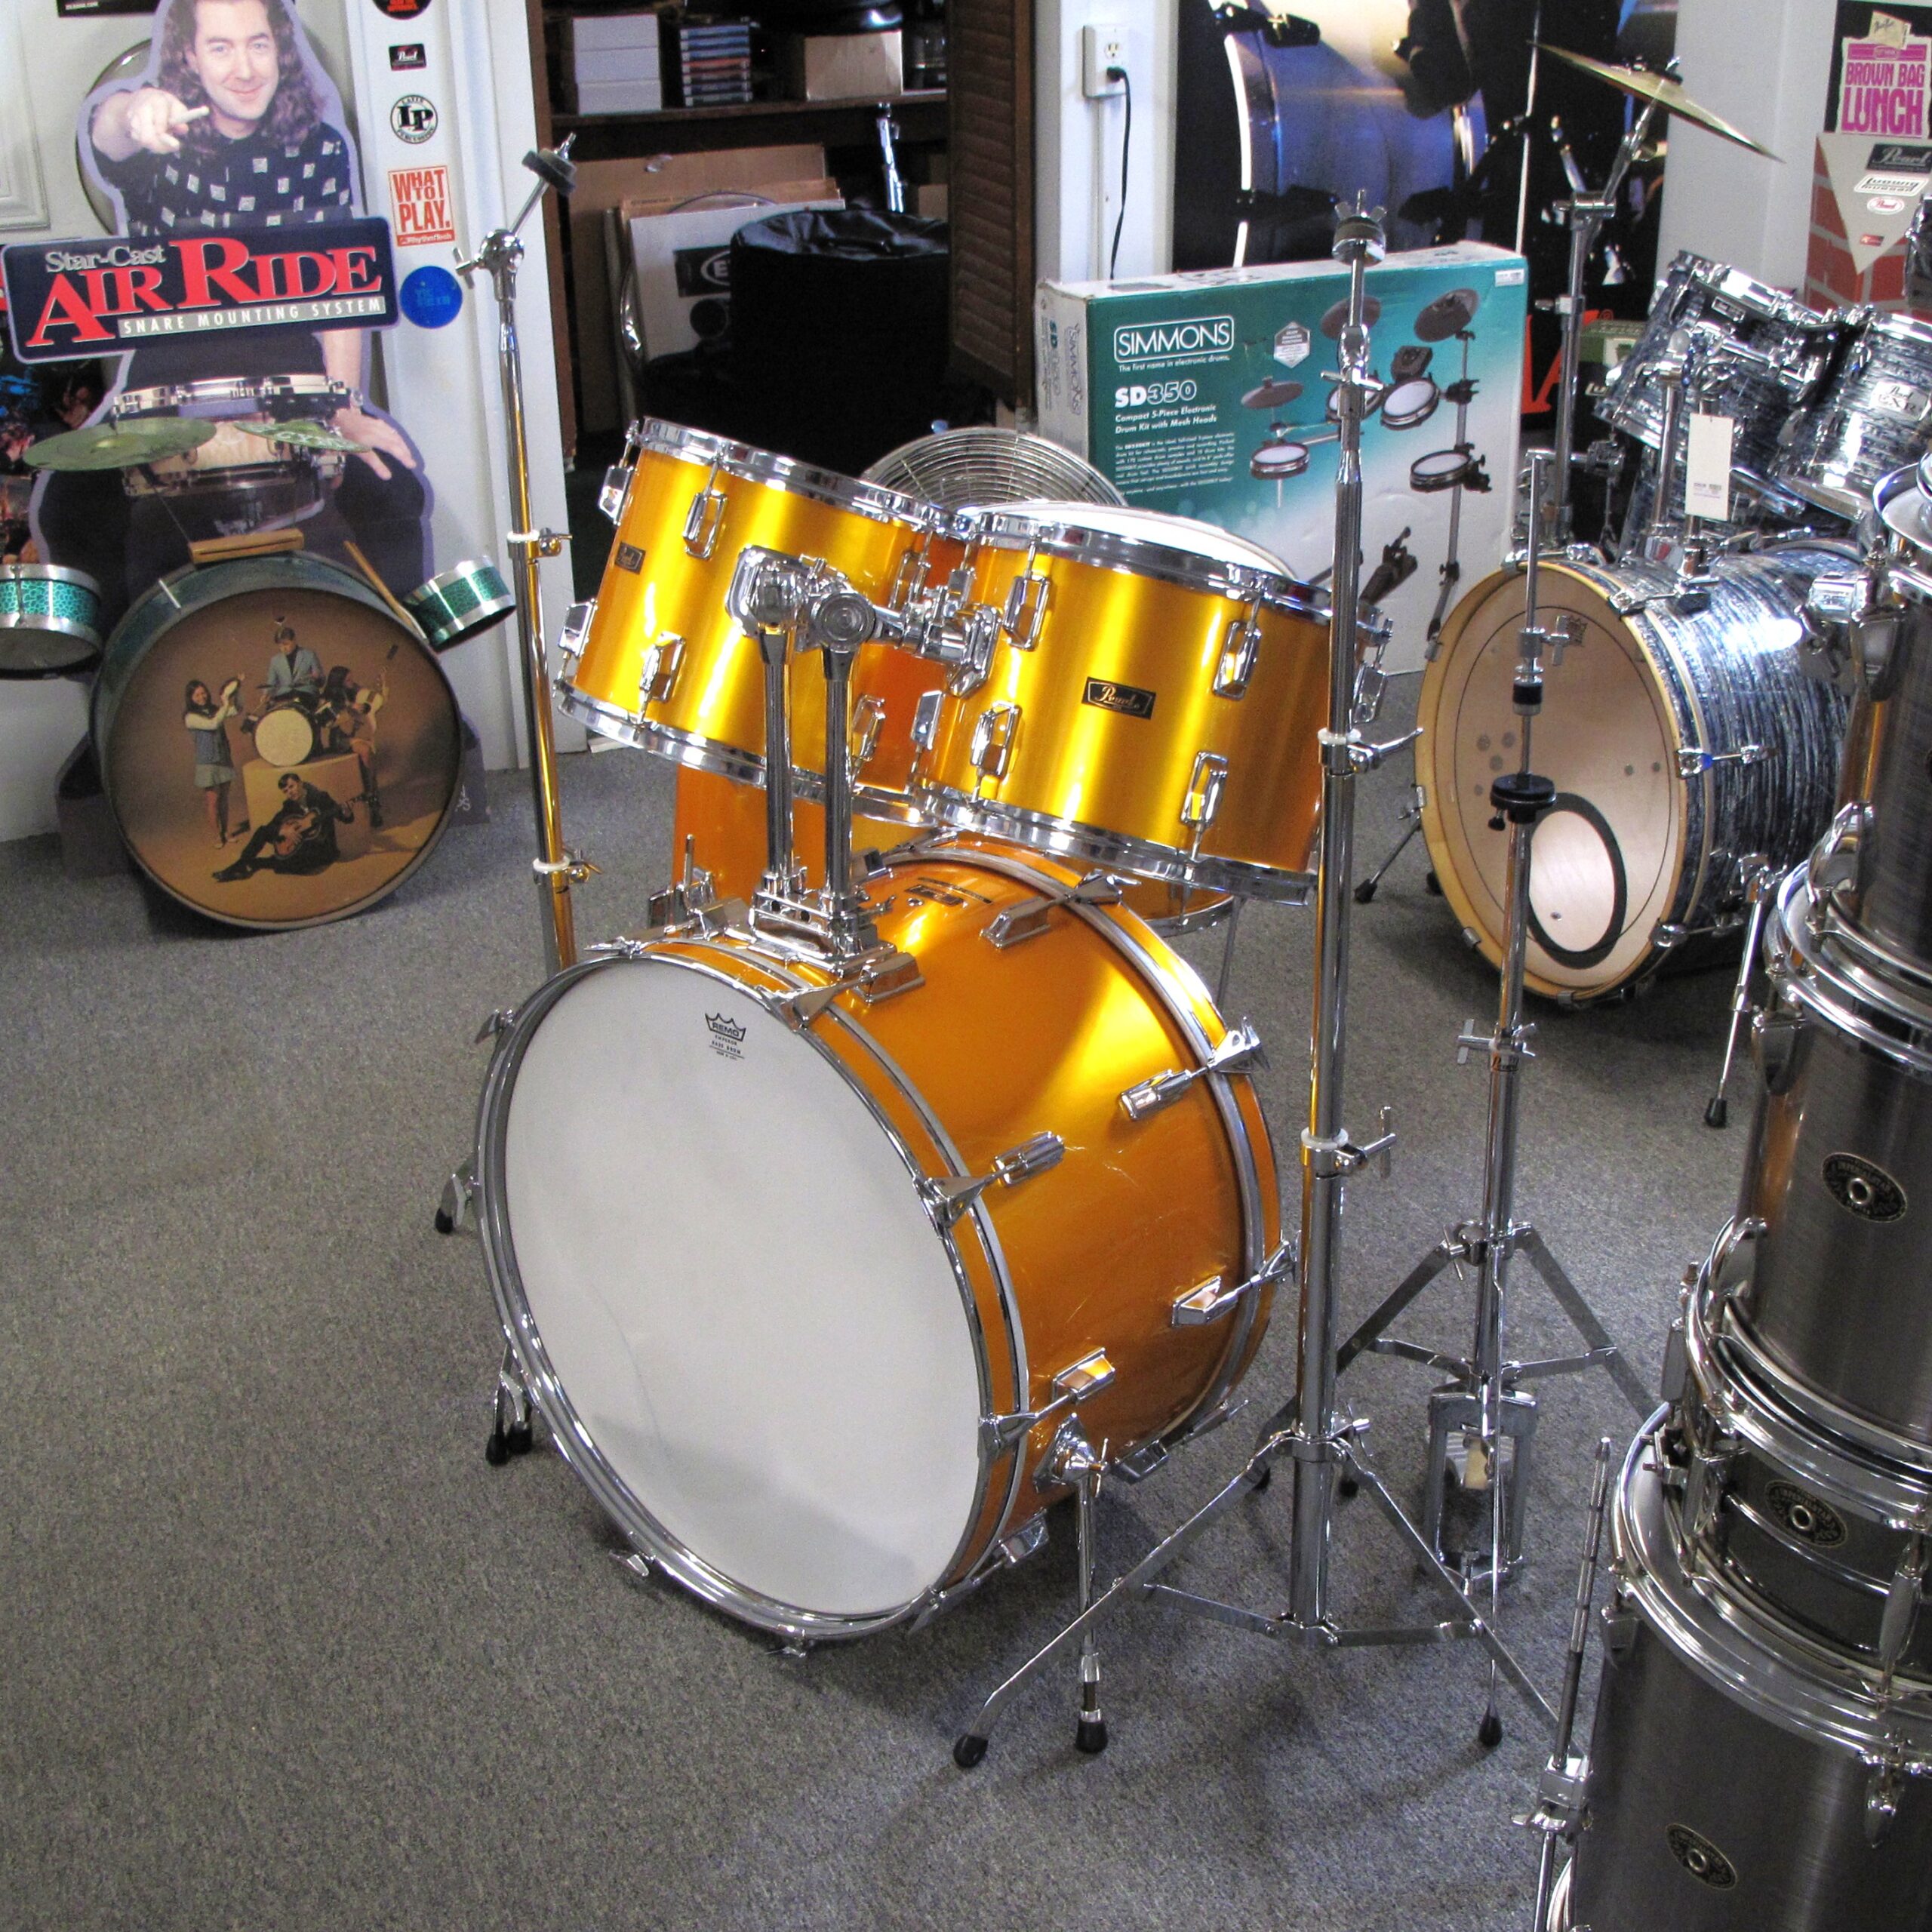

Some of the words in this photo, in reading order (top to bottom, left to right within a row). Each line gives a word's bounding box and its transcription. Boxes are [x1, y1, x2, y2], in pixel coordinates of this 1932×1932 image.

[1845, 62, 1894, 87] BROWN
[1897, 63, 1925, 88] BAG
[397, 105, 434, 132] LP
[1841, 87, 1924, 135] LUNCH
[392, 169, 445, 202] WHAT
[413, 186, 435, 201] TO
[399, 200, 451, 232] PLAY.
[45, 245, 166, 273] Star-Cast
[25, 266, 174, 348] AIR
[168, 237, 383, 309] RIDE
[123, 315, 185, 334] SNARE
[198, 305, 299, 328] MOUNTING
[312, 297, 381, 317] SYSTEM
[1118, 322, 1231, 356] SIMMONS
[1132, 362, 1146, 371] first
[1174, 356, 1207, 366] electronic
[1115, 380, 1197, 408] SD350
[1115, 412, 1149, 423] Compact
[1151, 408, 1179, 418] 5-Piece
[1180, 404, 1217, 415] Electronic
[1115, 426, 1137, 434] Drum
[1151, 420, 1168, 429] with
[1170, 417, 1190, 427] Mesh
[1192, 414, 1217, 424] Heads
[1094, 685, 1137, 707] Pearl
[712, 1022, 740, 1038] REMO
